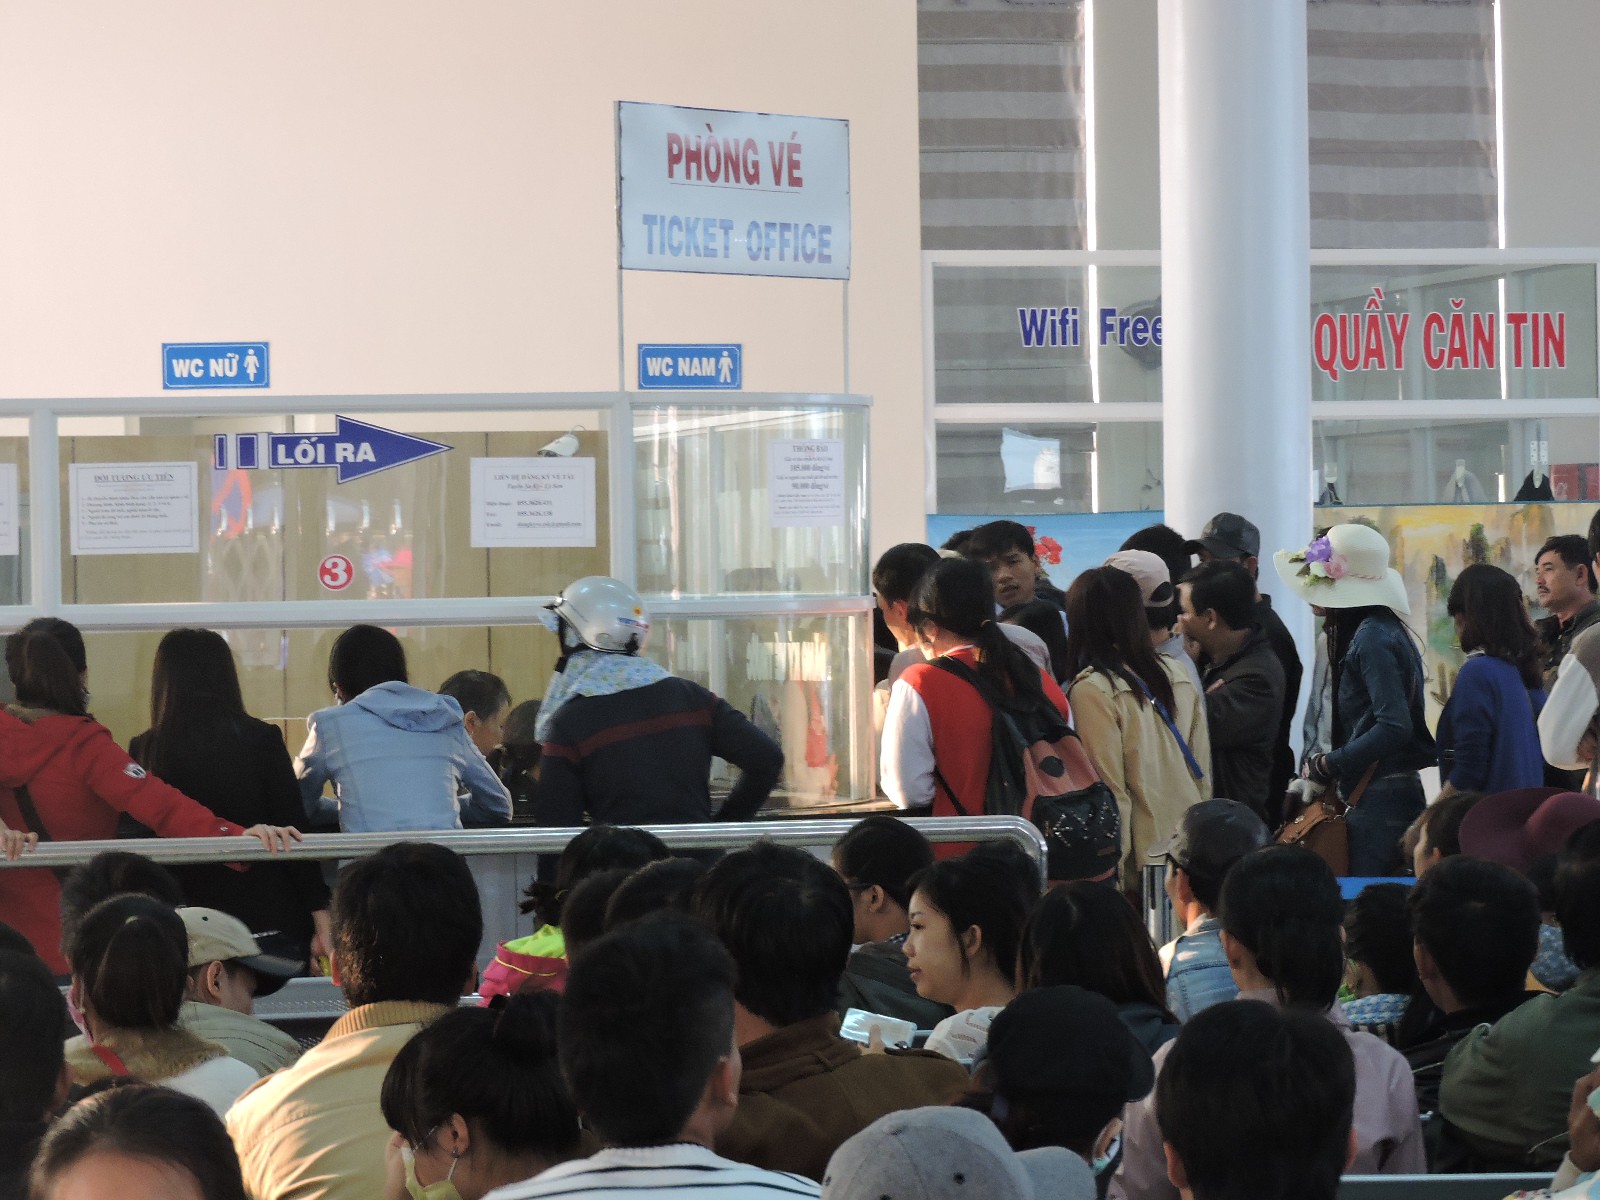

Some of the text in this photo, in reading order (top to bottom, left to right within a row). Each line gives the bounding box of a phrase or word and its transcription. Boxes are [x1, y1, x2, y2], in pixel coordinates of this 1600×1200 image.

[666, 122, 803, 188] PHÒNG VÉ
[642, 213, 832, 265] TICKET OFFICE
[1017, 307, 1162, 347] Wifi Free
[1313, 287, 1567, 382] QUẦY CĂN TIN
[172, 352, 239, 378] WC NỮ
[646, 357, 716, 377] WC NAM
[277, 436, 377, 464] LỐI RA
[323, 557, 348, 586] 3
